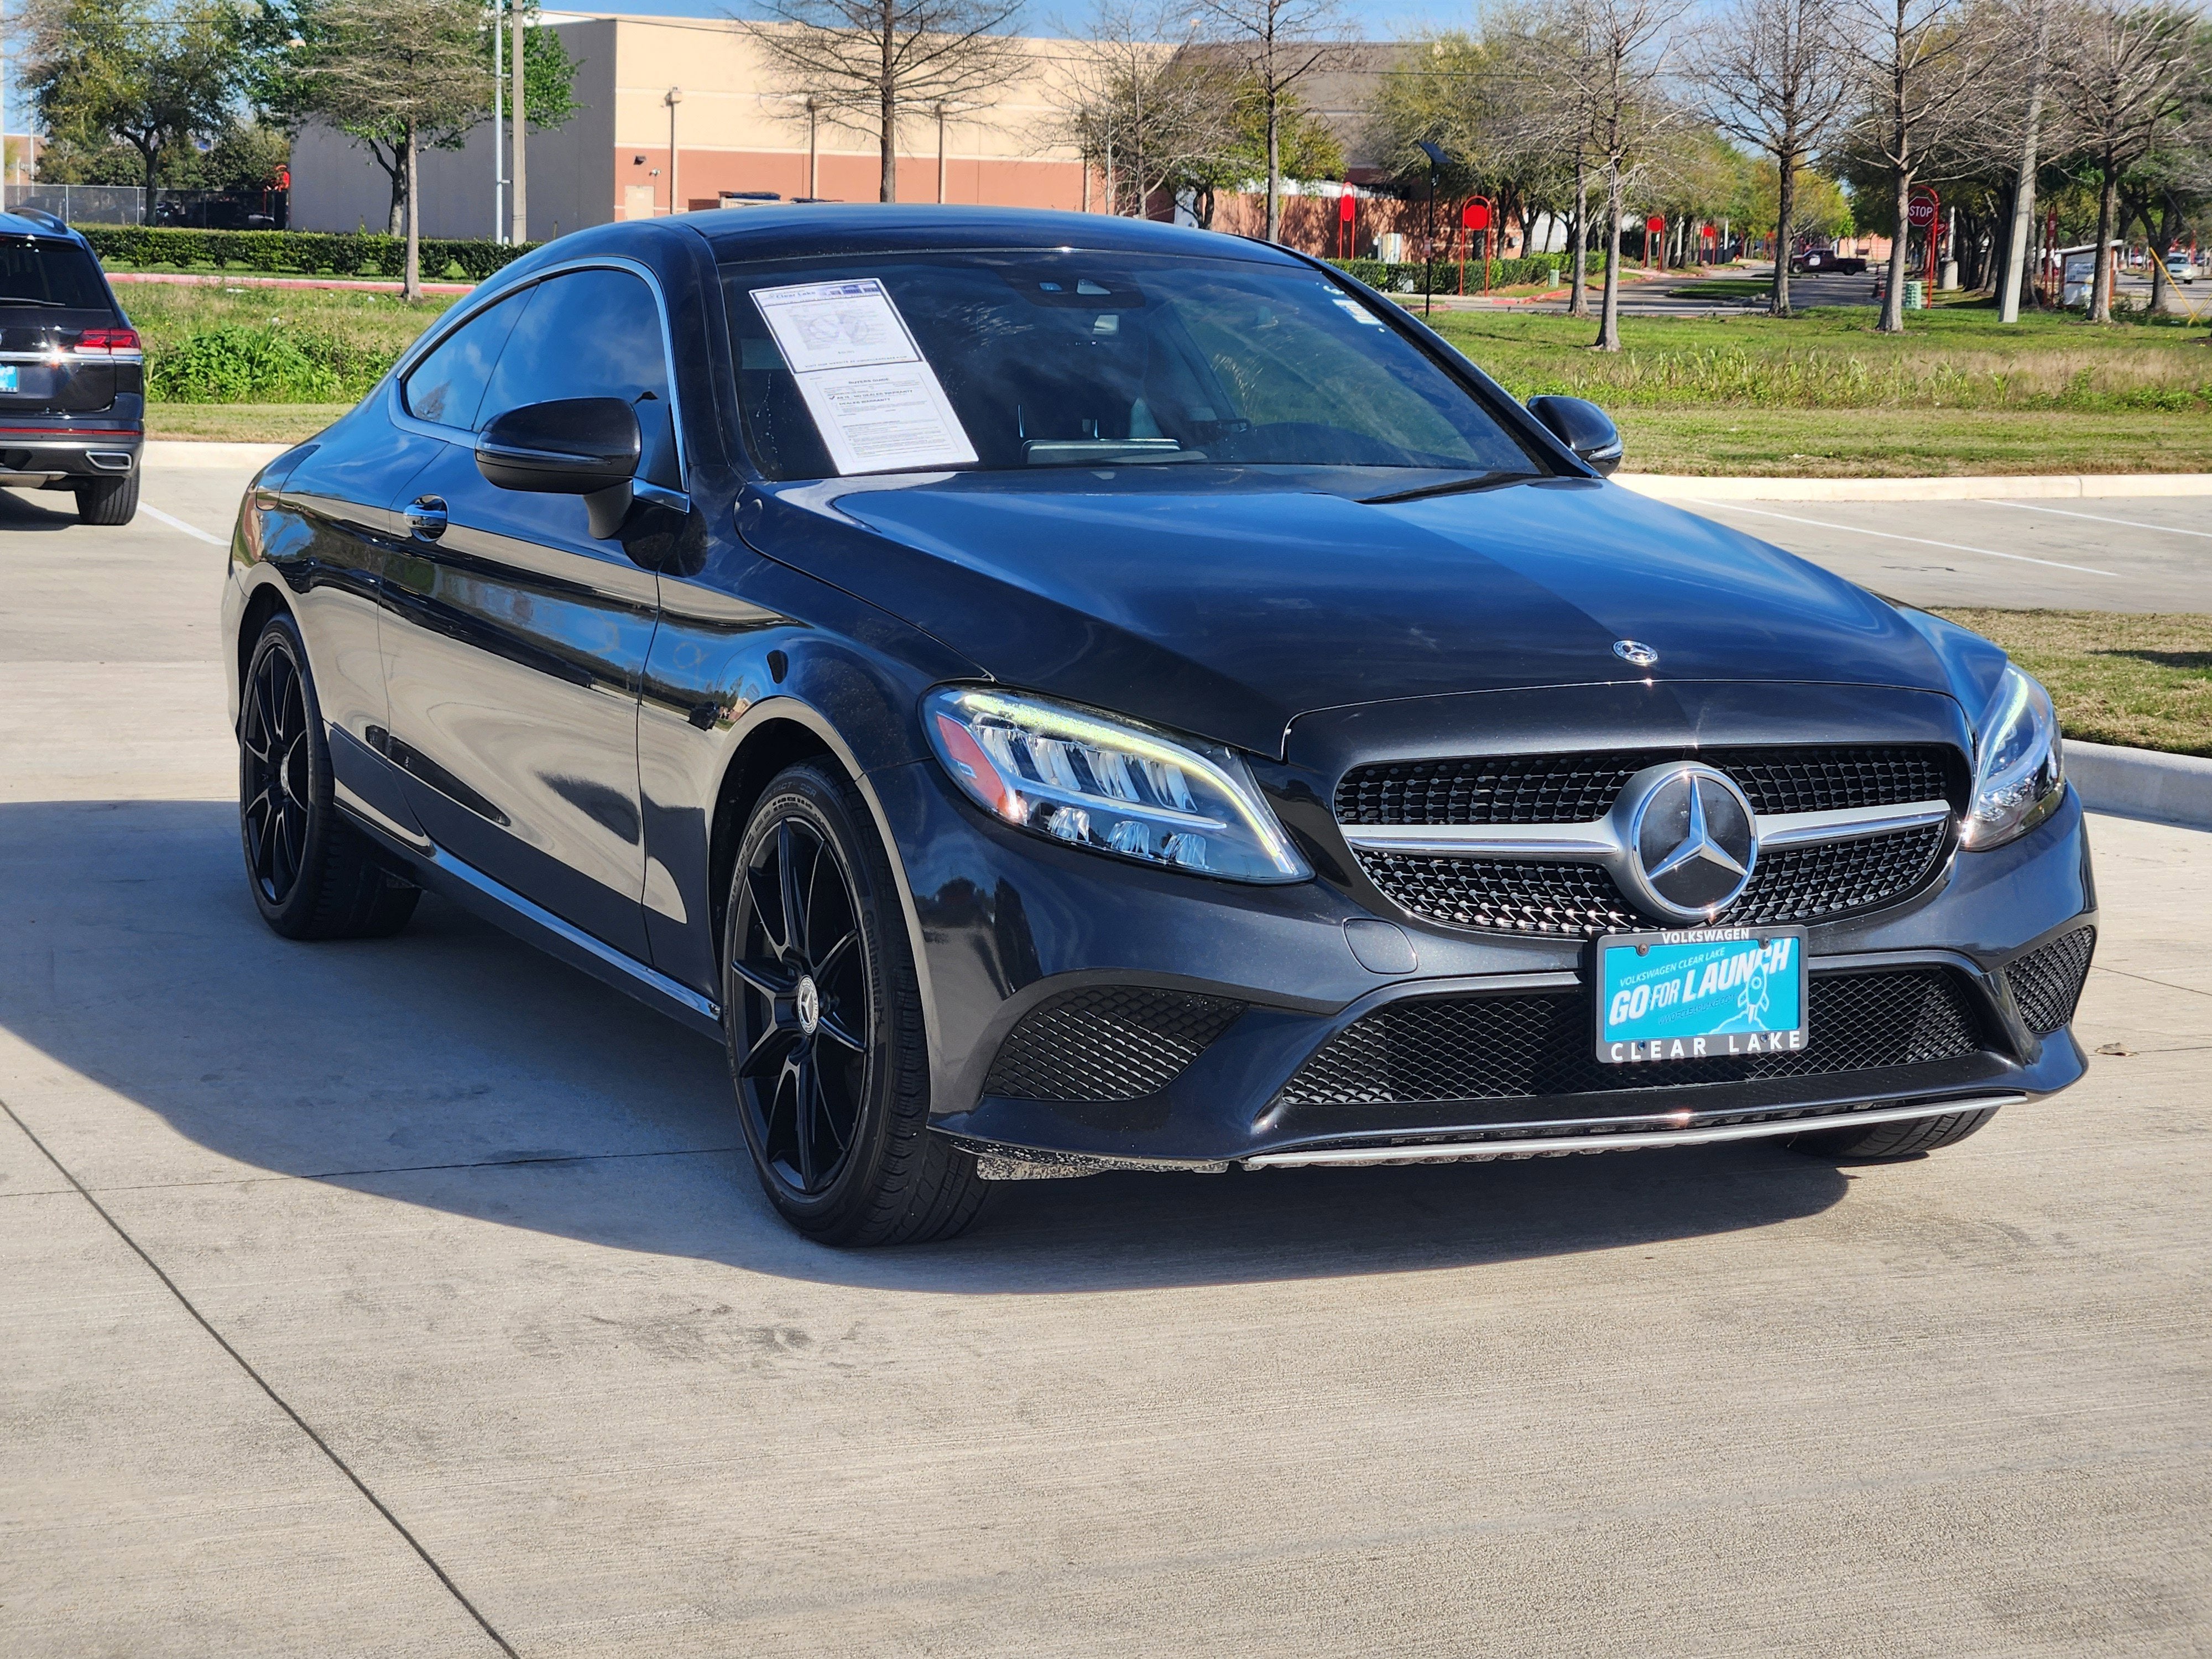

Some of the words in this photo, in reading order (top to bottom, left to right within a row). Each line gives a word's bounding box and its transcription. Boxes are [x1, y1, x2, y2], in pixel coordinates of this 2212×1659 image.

[1909, 205, 1933, 217] STOP
[1662, 928, 1750, 945] VOLKSWAGEN
[1609, 985, 1650, 1026] GO
[1651, 978, 1680, 1010] FOR
[1682, 937, 1792, 1002] LAUNCH
[1620, 962, 1678, 988] VOLKSWAGEN
[1678, 953, 1704, 969] CLEAR
[1705, 947, 1726, 962] LAKE
[1611, 1037, 1707, 1062] CLEAR
[1729, 1031, 1801, 1053] LAKE
